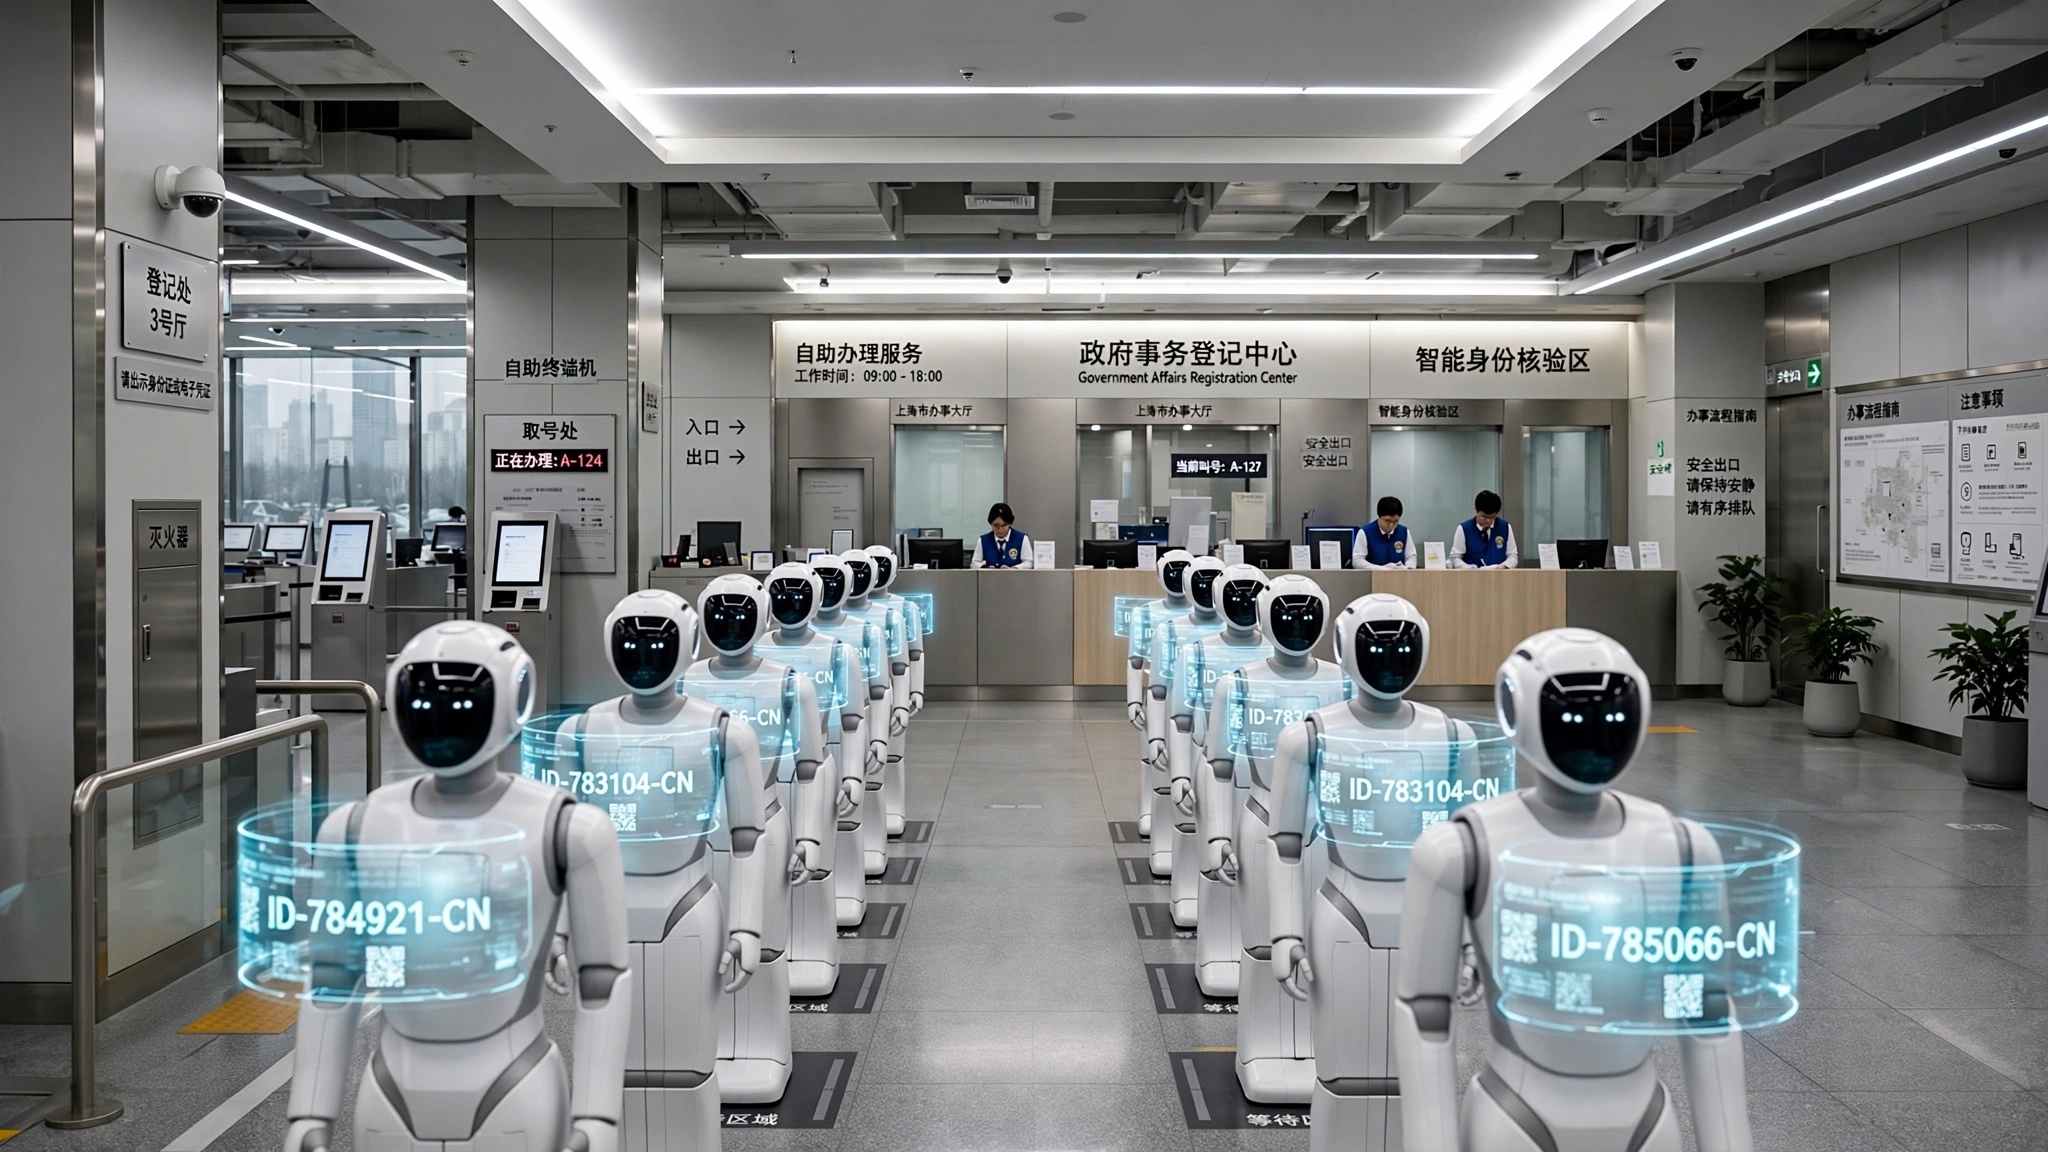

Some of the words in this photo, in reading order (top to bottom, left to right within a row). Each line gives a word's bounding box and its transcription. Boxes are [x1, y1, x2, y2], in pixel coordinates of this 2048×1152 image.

[146, 266, 192, 305] 登记处
[149, 308, 187, 340] 3号厅
[796, 342, 923, 365] 自助办理服务
[1079, 339, 1298, 367] 政府事务登记中心
[1415, 346, 1591, 374] 智能身份核验区
[863, 369, 897, 383] 09:00
[909, 369, 943, 383] 18:00
[1078, 370, 1148, 384] Government
[1151, 370, 1187, 384] Affairs
[1190, 370, 1257, 387] Registration
[1260, 370, 1298, 384] Center
[522, 420, 578, 441] 取号处
[685, 418, 719, 436] 入口
[560, 453, 603, 467] A-124
[686, 448, 719, 466] 出口
[1229, 460, 1262, 473] A-127
[1303, 454, 1348, 468] 安全出口
[1686, 456, 1740, 473] 安全出口
[1686, 499, 1756, 516] 请有序排队
[149, 524, 189, 549] 灭火器
[1350, 777, 1500, 803] ID-783104-CN
[267, 895, 491, 935] ID-784921-CN
[1551, 920, 1776, 963] ID-785066-CN
[720, 1113, 779, 1126] 区域
